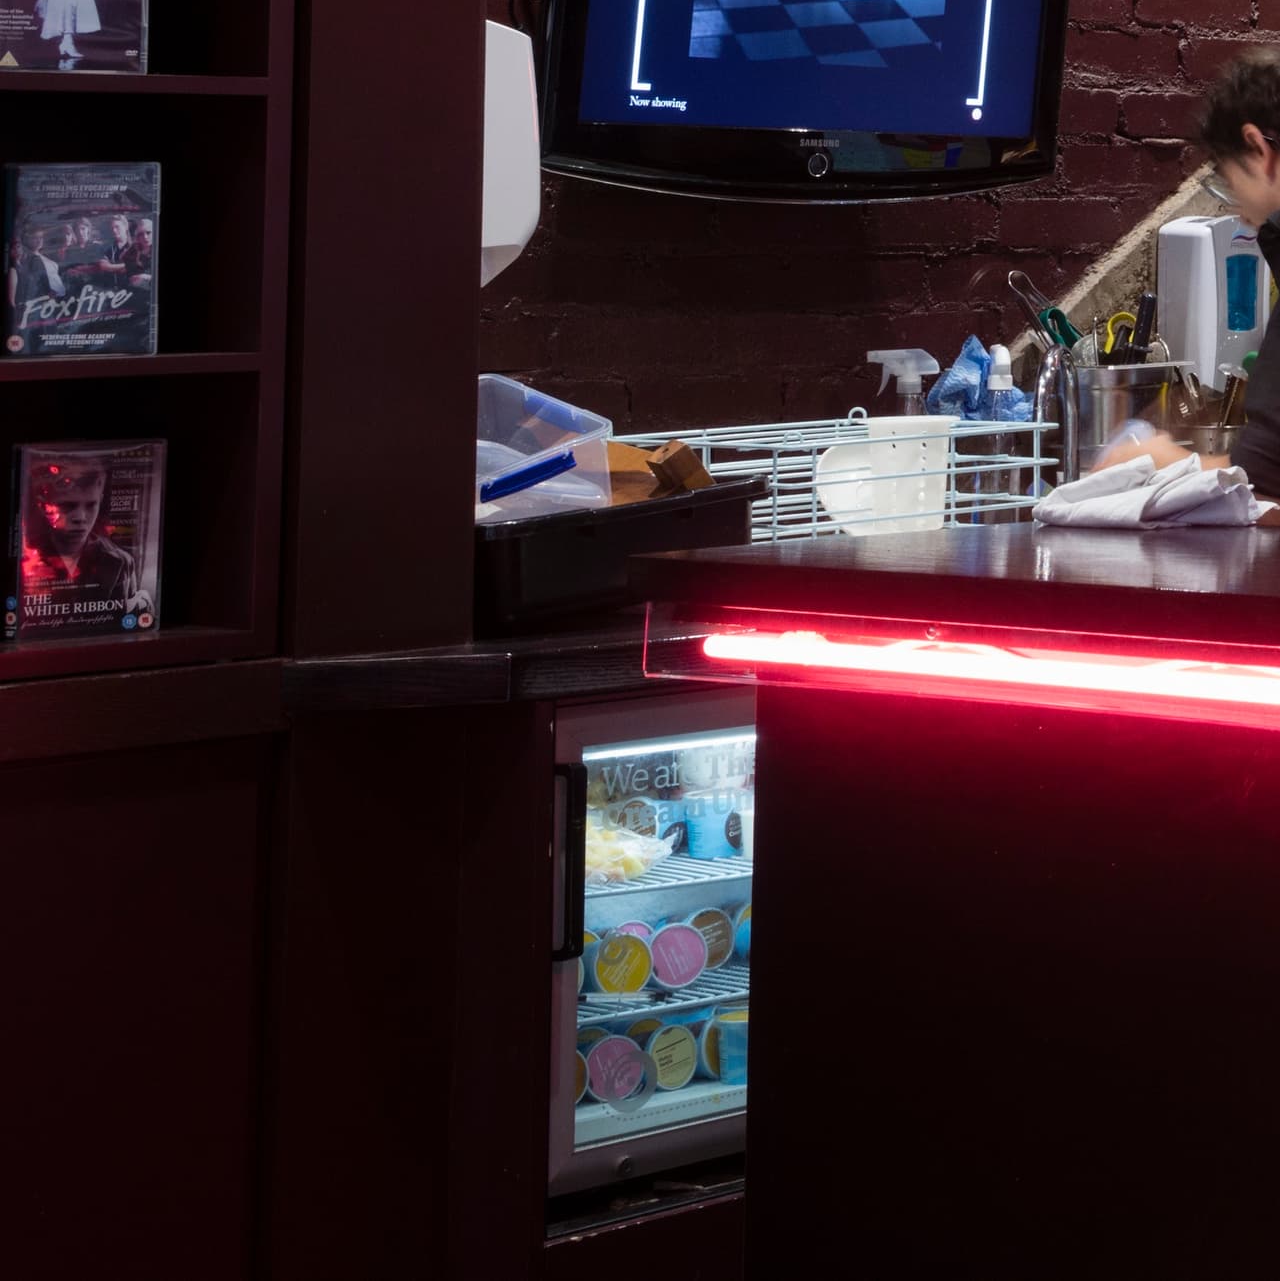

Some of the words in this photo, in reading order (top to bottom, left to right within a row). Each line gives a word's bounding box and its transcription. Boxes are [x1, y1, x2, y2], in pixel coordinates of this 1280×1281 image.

[630, 96, 650, 107] Now
[651, 96, 687, 111] showing
[800, 138, 840, 148] SAMSUNG
[18, 284, 133, 330] Foxfire
[24, 594, 52, 606] THE
[24, 605, 71, 617] WHITE
[74, 599, 126, 614] RIBBON
[602, 764, 649, 796] We
